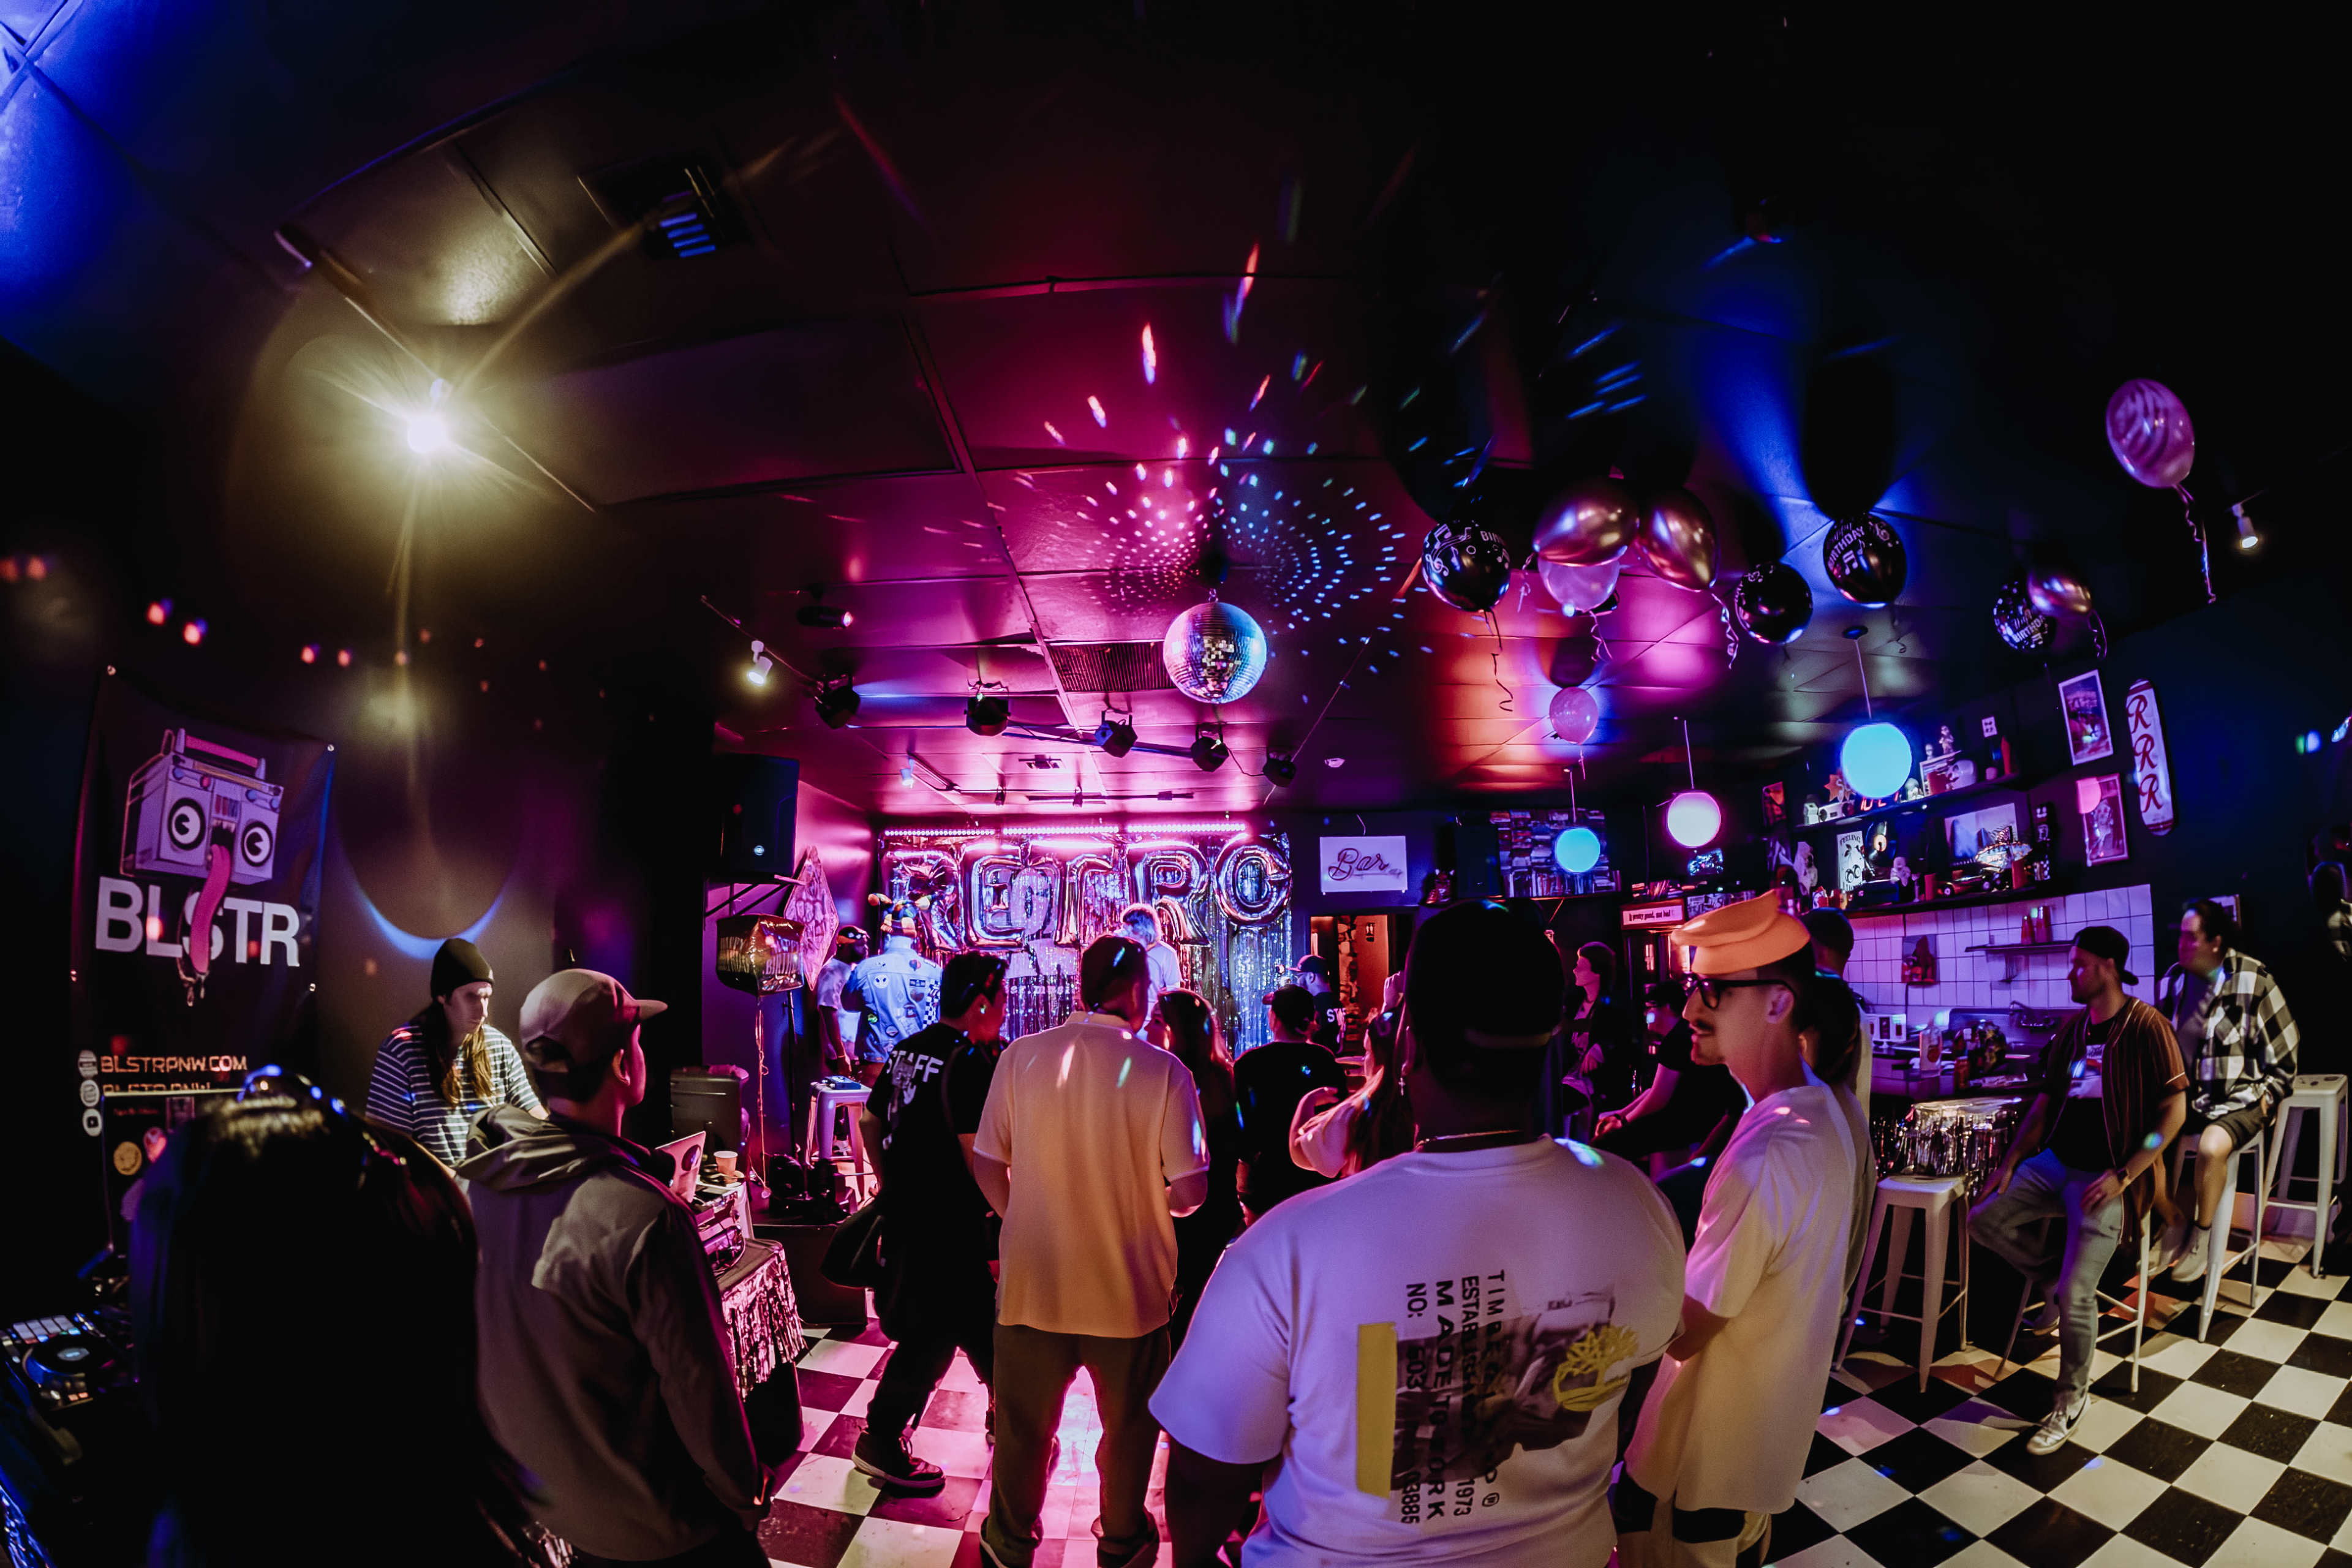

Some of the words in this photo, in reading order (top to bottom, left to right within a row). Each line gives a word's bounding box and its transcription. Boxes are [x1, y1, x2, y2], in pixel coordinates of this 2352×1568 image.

[1839, 834, 1861, 846] FEELING
[1328, 847, 1389, 881] Bar
[884, 832, 1292, 950] RETRO
[95, 876, 300, 967] BLSTR
[100, 1054, 248, 1074] BLSTRPNW.COM
[886, 1049, 946, 1084] STAFF
[1406, 1283, 1427, 1319] NO:
[1433, 1280, 1454, 1389] MADE
[1430, 1395, 1450, 1425] TO
[1401, 1471, 1421, 1525] 03885
[1453, 1479, 1474, 1517] 1973
